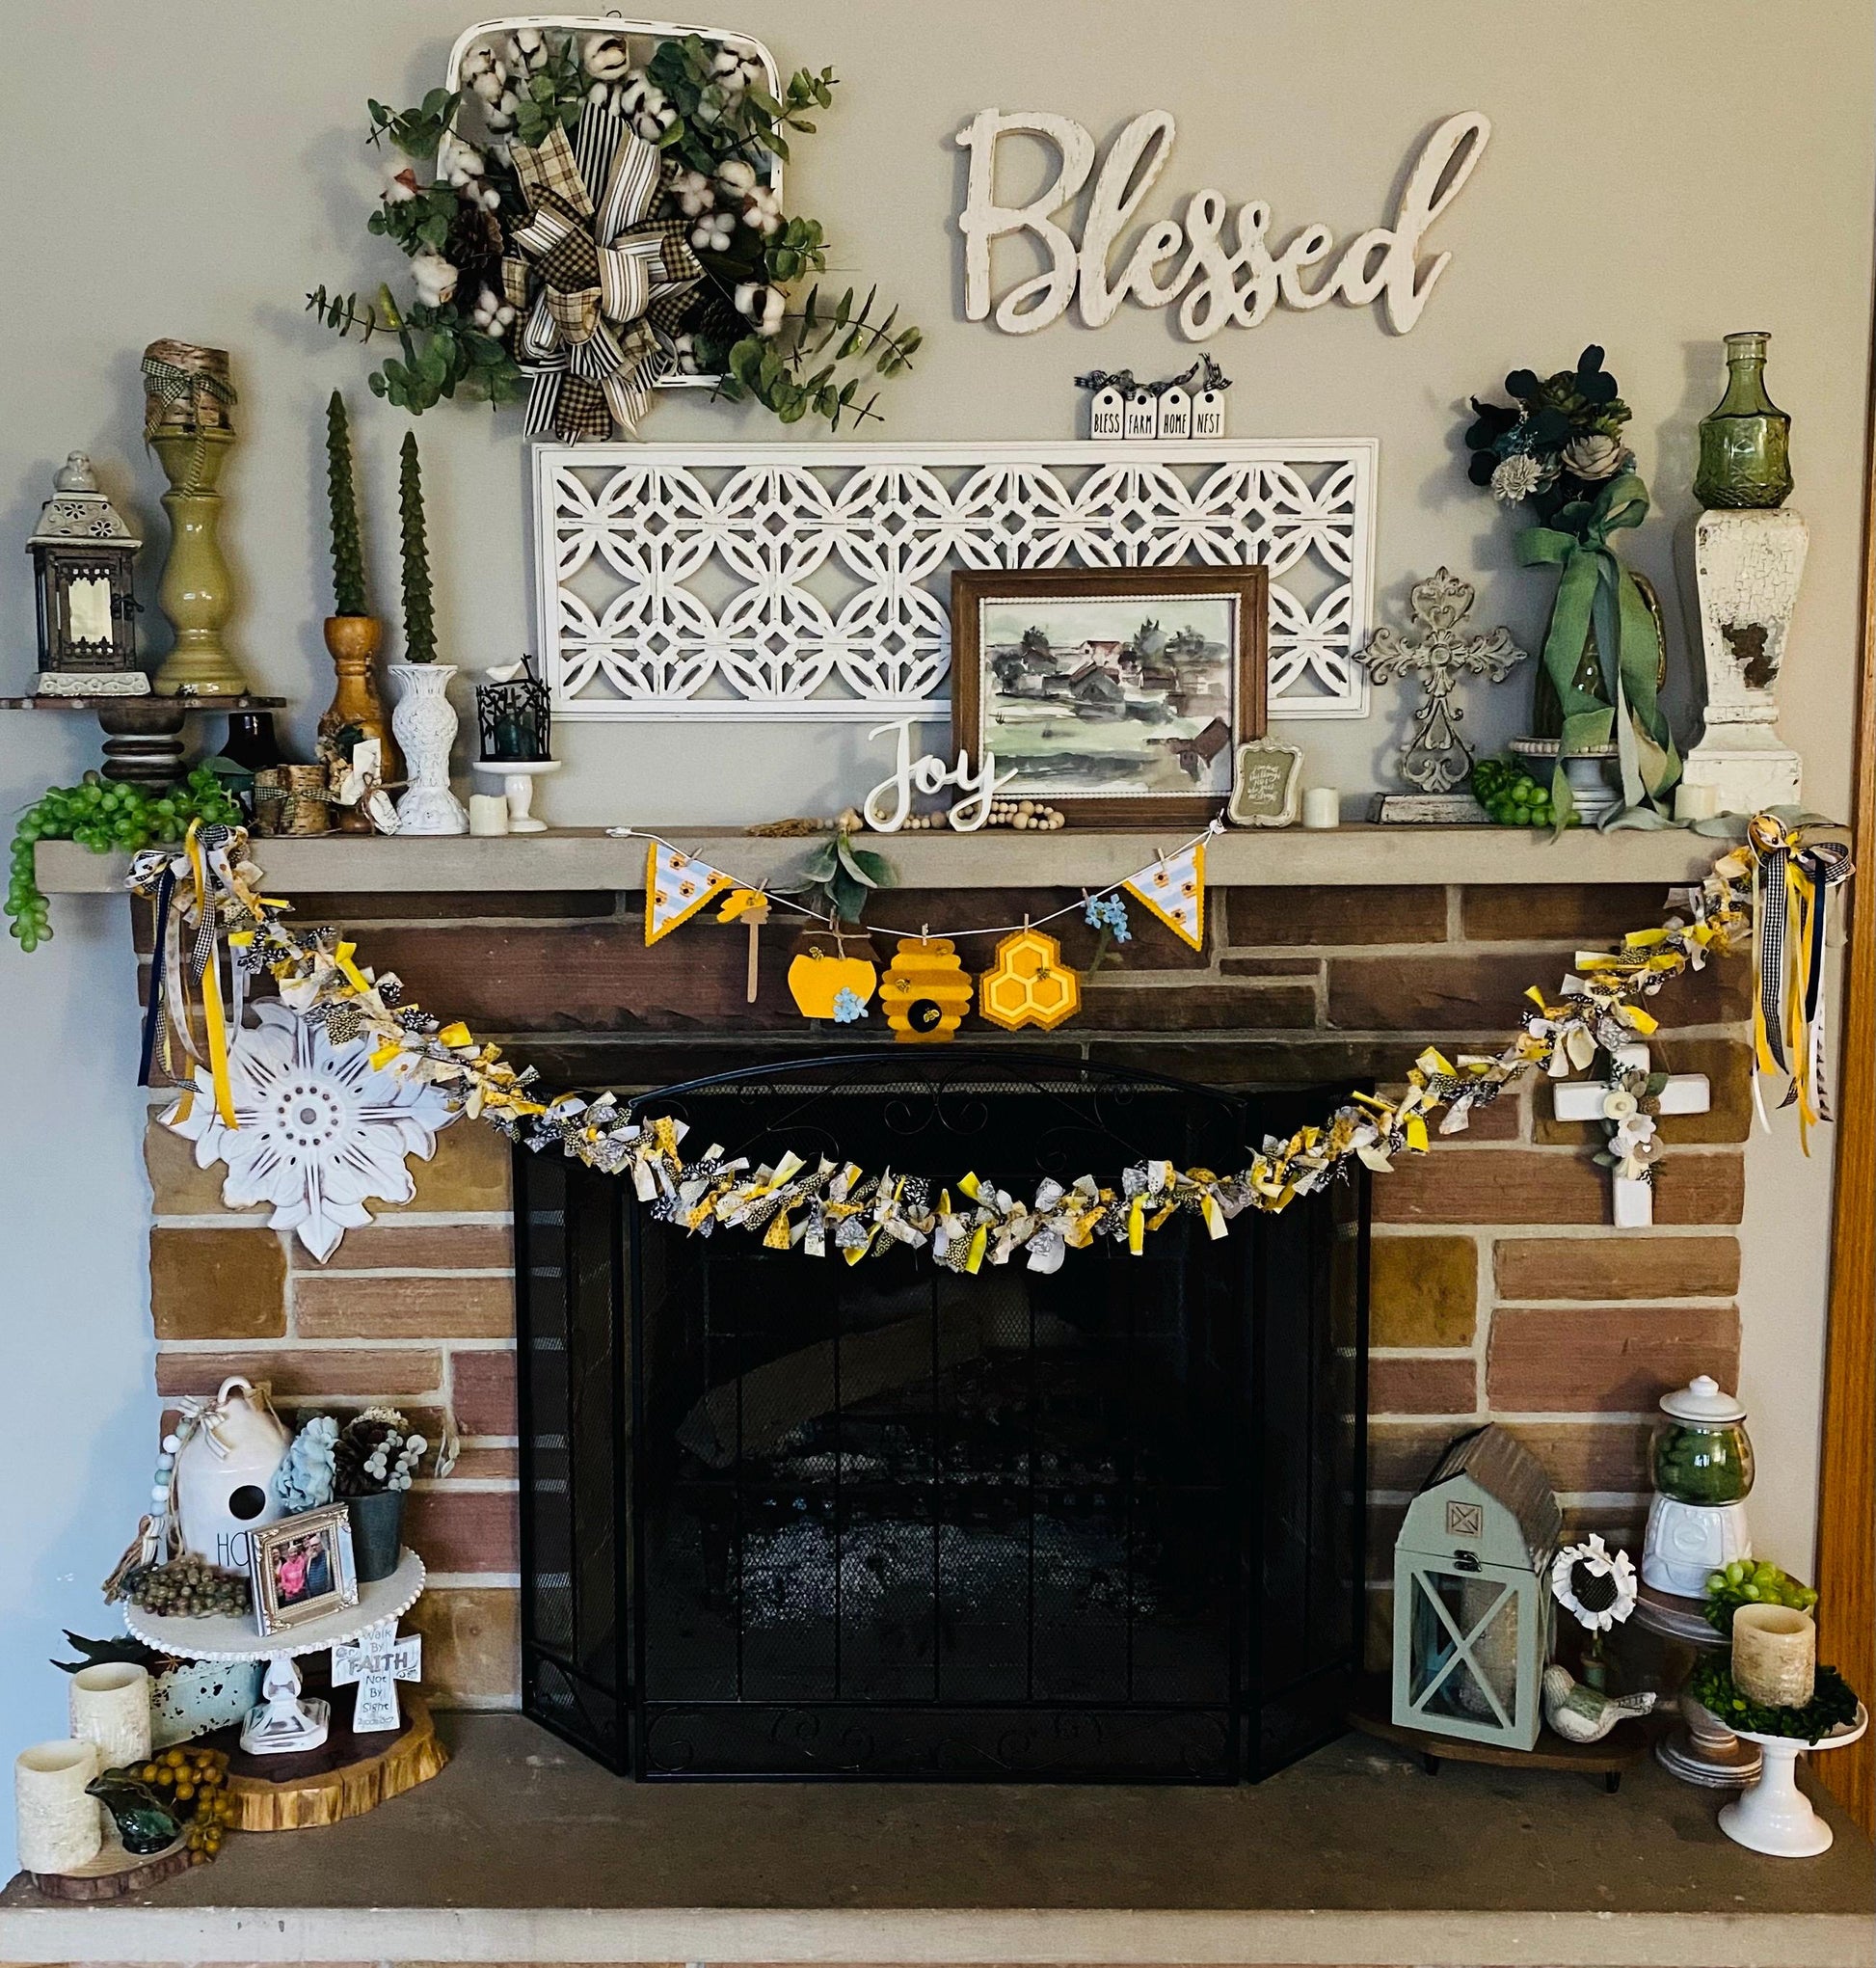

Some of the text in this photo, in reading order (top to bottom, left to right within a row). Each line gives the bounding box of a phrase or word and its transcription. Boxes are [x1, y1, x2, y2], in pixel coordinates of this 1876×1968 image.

[955, 108, 1491, 342] Blessed
[1093, 413, 1120, 433] BLESS
[1128, 414, 1152, 434] FARM
[1164, 414, 1187, 434] HOME
[1196, 414, 1220, 433] NEST
[864, 716, 1019, 833] Joy
[363, 1629, 391, 1640] Walk
[370, 1643, 384, 1654] By
[348, 1652, 408, 1676] FAITH
[365, 1676, 388, 1685] Not
[370, 1687, 383, 1698] By
